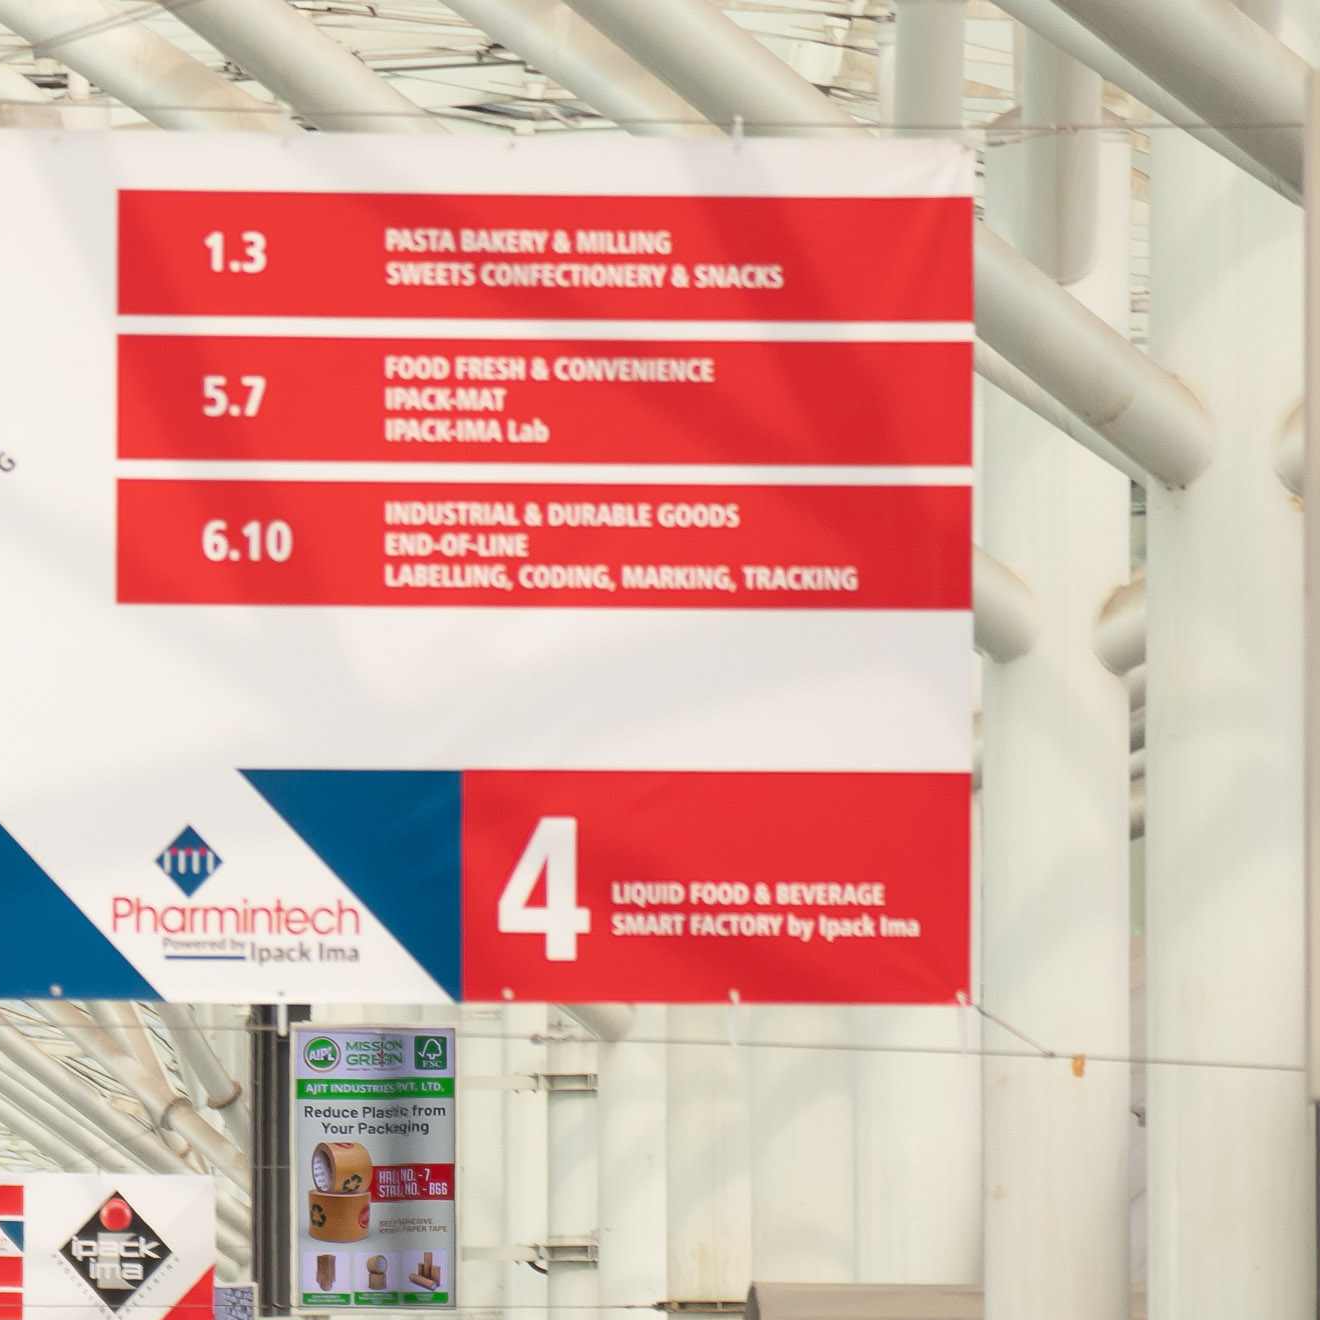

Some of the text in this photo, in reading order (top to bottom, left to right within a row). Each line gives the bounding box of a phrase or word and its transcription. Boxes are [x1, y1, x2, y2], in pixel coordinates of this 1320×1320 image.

[204, 231, 267, 273] 1.3
[385, 228, 672, 255] PASTA BAKERY & MILLING
[386, 261, 784, 289] SWEETS CONFECTIONERY & SNACKS
[385, 356, 715, 383] FOOD FRESH & CONVENIENCE
[202, 375, 266, 417] 5.7
[385, 387, 506, 411] IPACK-MAT
[385, 418, 550, 443] IPACK-IMA Lab
[384, 502, 740, 529] INDUSTRIAL & DURABLE GOODS
[202, 520, 293, 563] 6.10
[384, 532, 528, 558] END-OF-LINE
[384, 564, 859, 595] LABELLING, CODING, MARKING, TRACKING
[497, 816, 591, 961] 4
[611, 881, 886, 907] LIQUID FOOD & BEVERAGE
[112, 897, 360, 935] Pharmintech
[611, 912, 921, 943] SMART FACTORY by Ipack Ima
[162, 937, 246, 953] Powered by
[251, 942, 359, 965] Ipack Ima
[422, 1060, 442, 1068] FSC
[331, 1083, 395, 1093] INDUSTRIES
[304, 1106, 358, 1119] Reduce
[412, 1105, 446, 1117] from
[322, 1122, 354, 1134] Your
